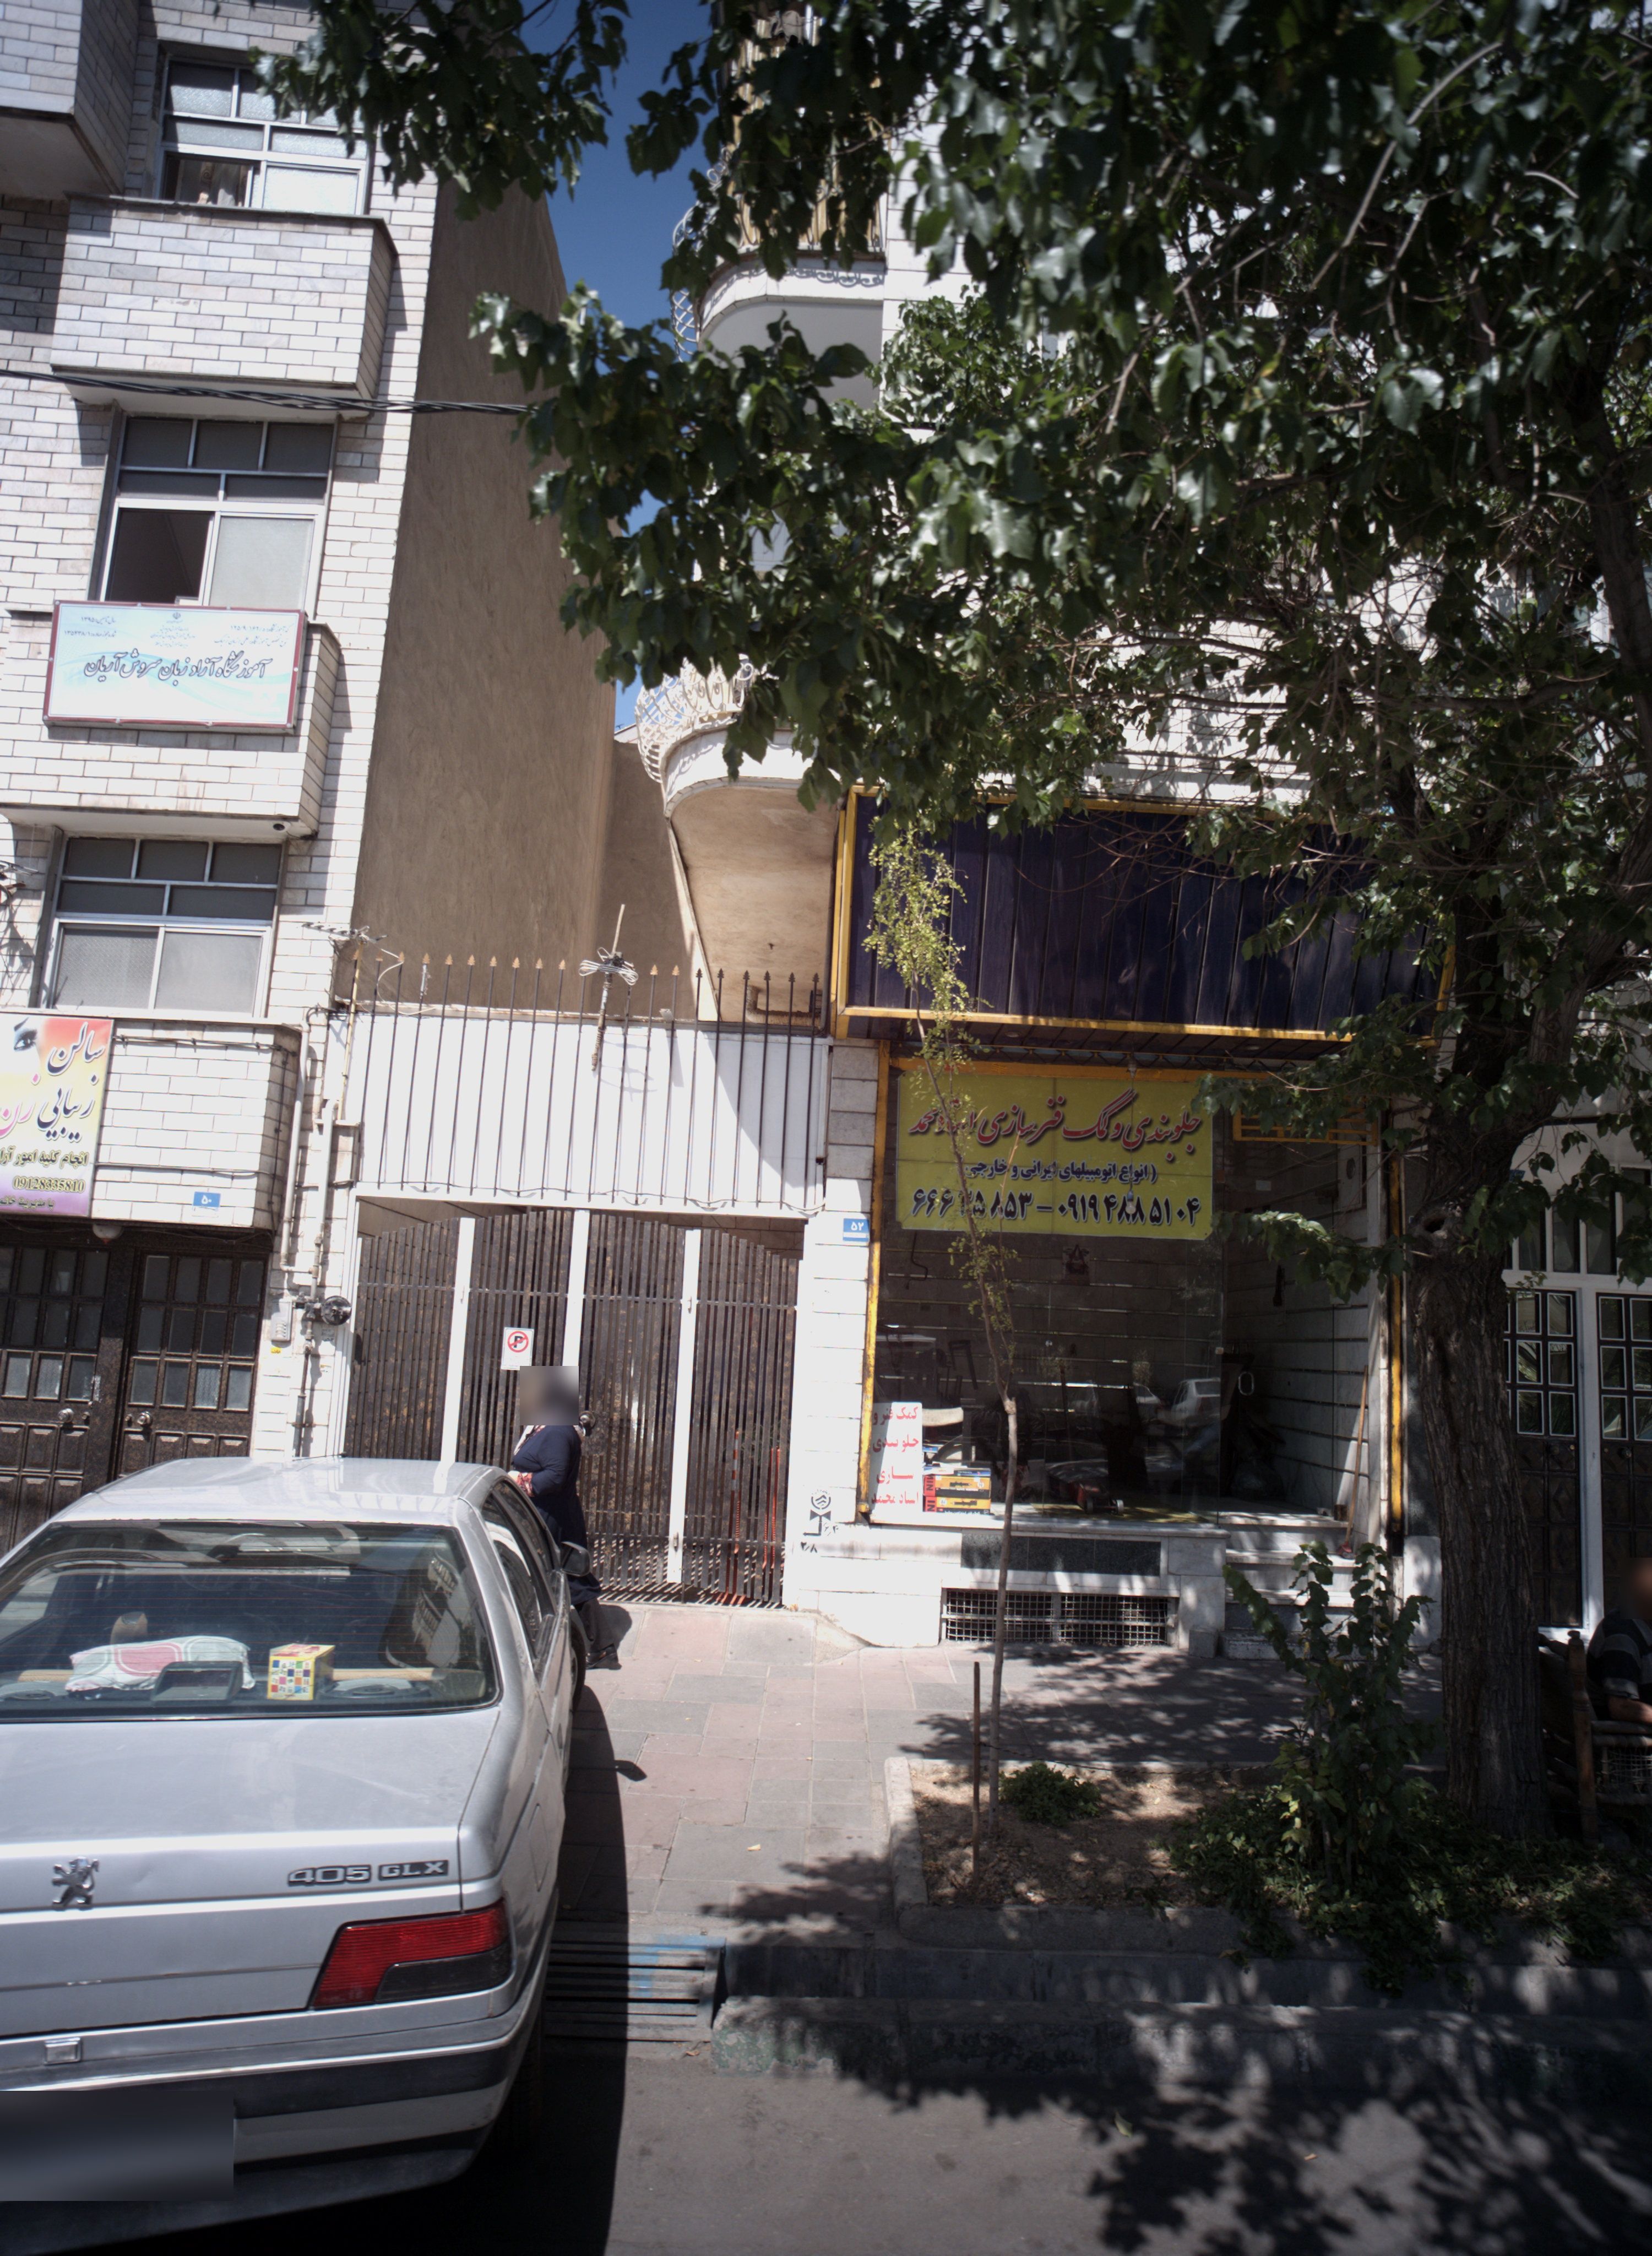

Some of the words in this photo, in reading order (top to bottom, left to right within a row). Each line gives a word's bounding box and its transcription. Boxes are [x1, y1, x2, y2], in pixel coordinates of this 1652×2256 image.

[84, 652, 128, 682] آریان
[119, 648, 162, 679] سروش
[158, 657, 191, 686] زبان
[189, 657, 222, 677] آزاد
[215, 650, 273, 678] آموزشگاه
[47, 1022, 106, 1075] سالن
[37, 1073, 97, 1141] زیبایی
[1109, 1121, 1123, 1139] و
[14, 1149, 38, 1165] امور
[39, 1150, 61, 1167] کلیه
[59, 1151, 89, 1169] انجام
[1010, 1164, 1018, 1179] و
[1020, 1159, 1057, 1179] ایرانی
[13, 1176, 86, 1194] 09128335810
[851, 1221, 864, 1231] ۵۲
[872, 1412, 878, 1425] و
[896, 1406, 919, 1419] کمک
[872, 1493, 895, 1504] محمد
[288, 1865, 371, 1885] 405
[379, 1861, 447, 1879] GLX
